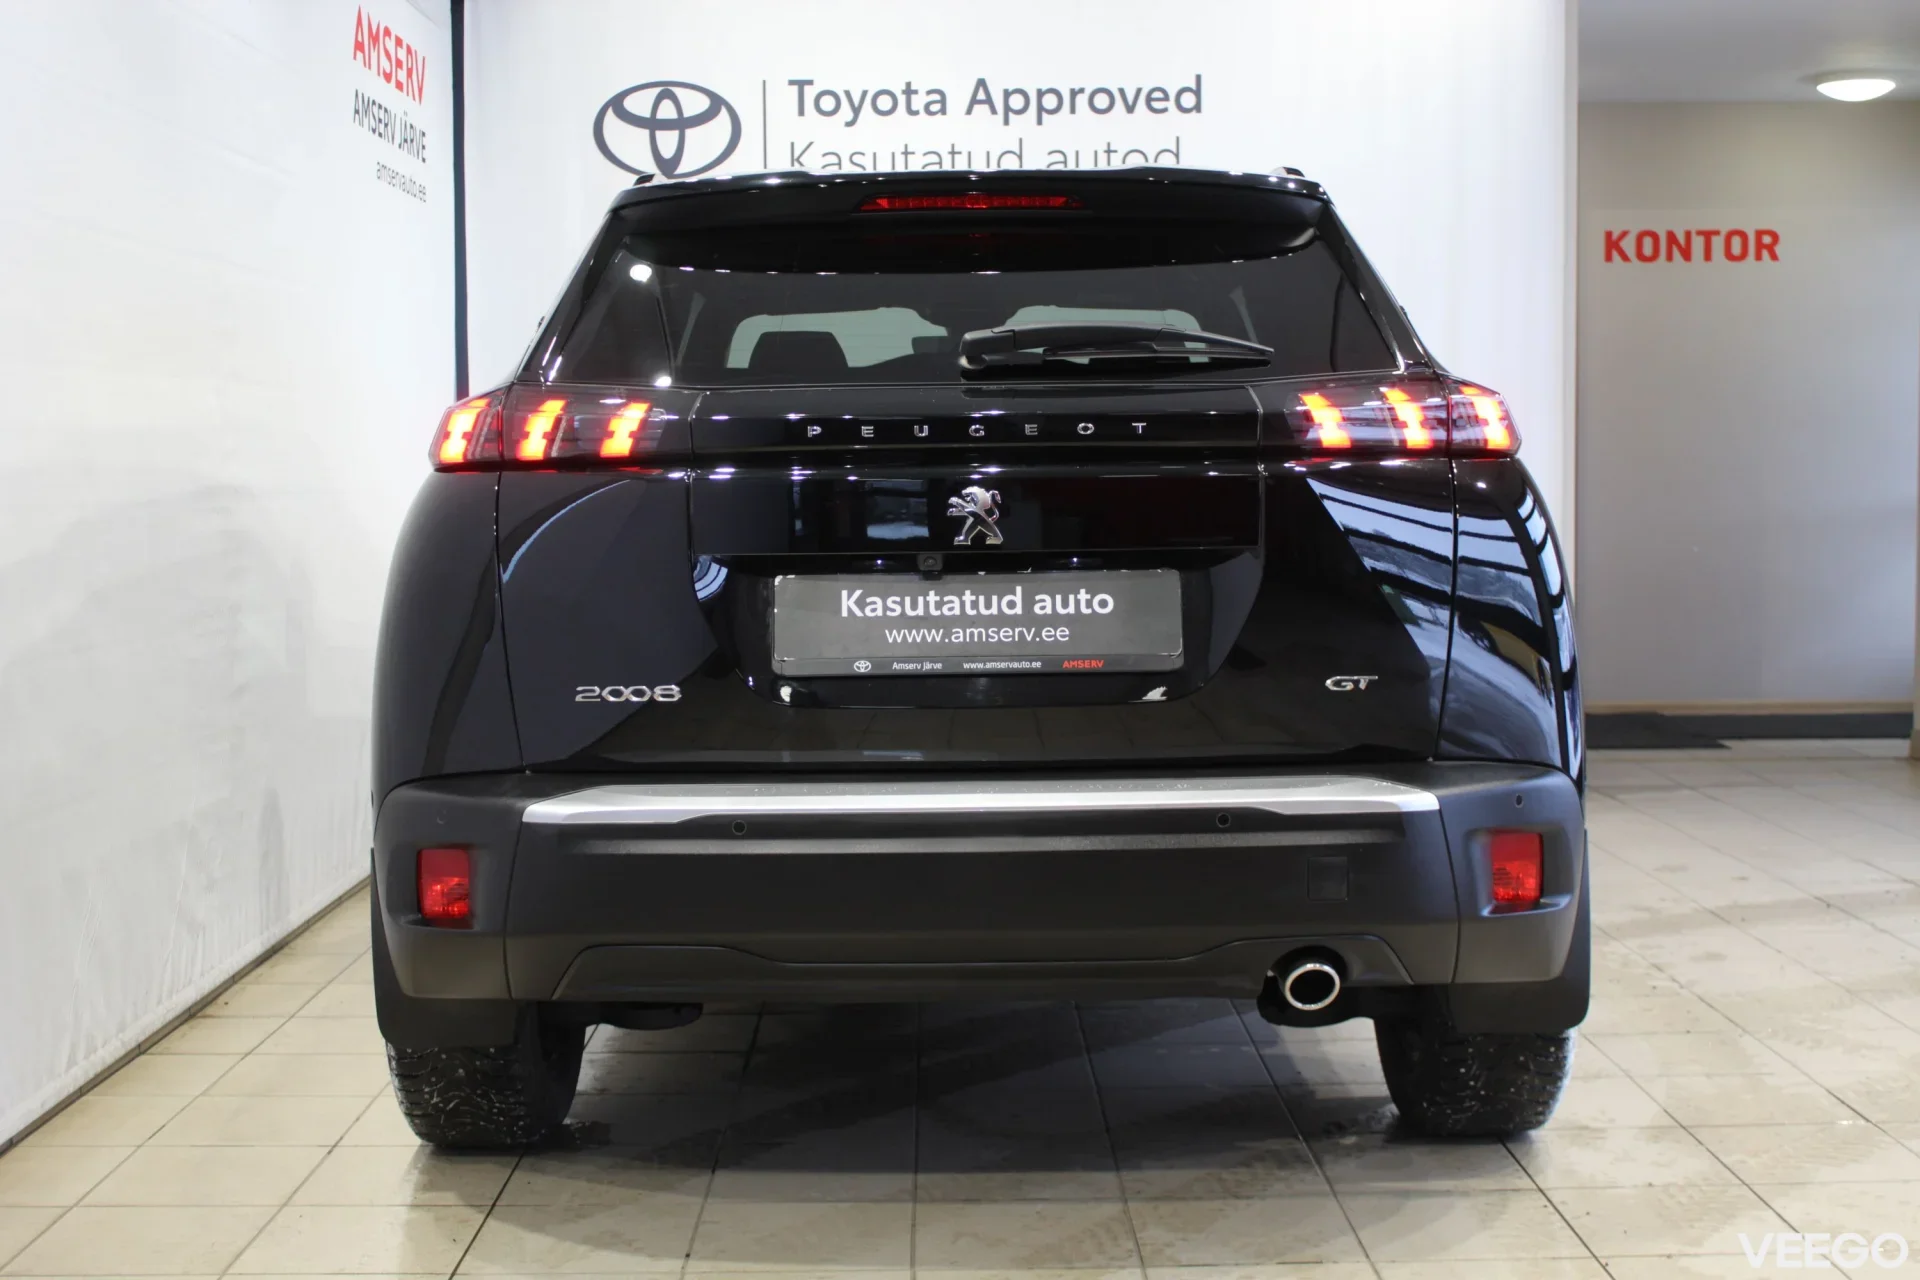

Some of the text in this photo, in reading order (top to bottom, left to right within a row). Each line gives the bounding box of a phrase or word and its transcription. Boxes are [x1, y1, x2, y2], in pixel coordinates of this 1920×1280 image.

[353, 4, 426, 106] AMSERV
[788, 74, 1202, 127] Toyota Approved
[353, 88, 426, 164] AMSERV JÄRVE
[376, 161, 427, 203] amservauto.ee
[1604, 229, 1780, 263] KONTOR
[807, 422, 1147, 438] PEUGEOT
[841, 586, 1114, 618] Kasutatud auto
[885, 626, 1070, 644] www.amserv.ee
[892, 660, 1105, 671] Amserv Järve www.amservauto.ee AMSERV
[575, 684, 682, 702] 2008
[1325, 675, 1378, 691] GT
